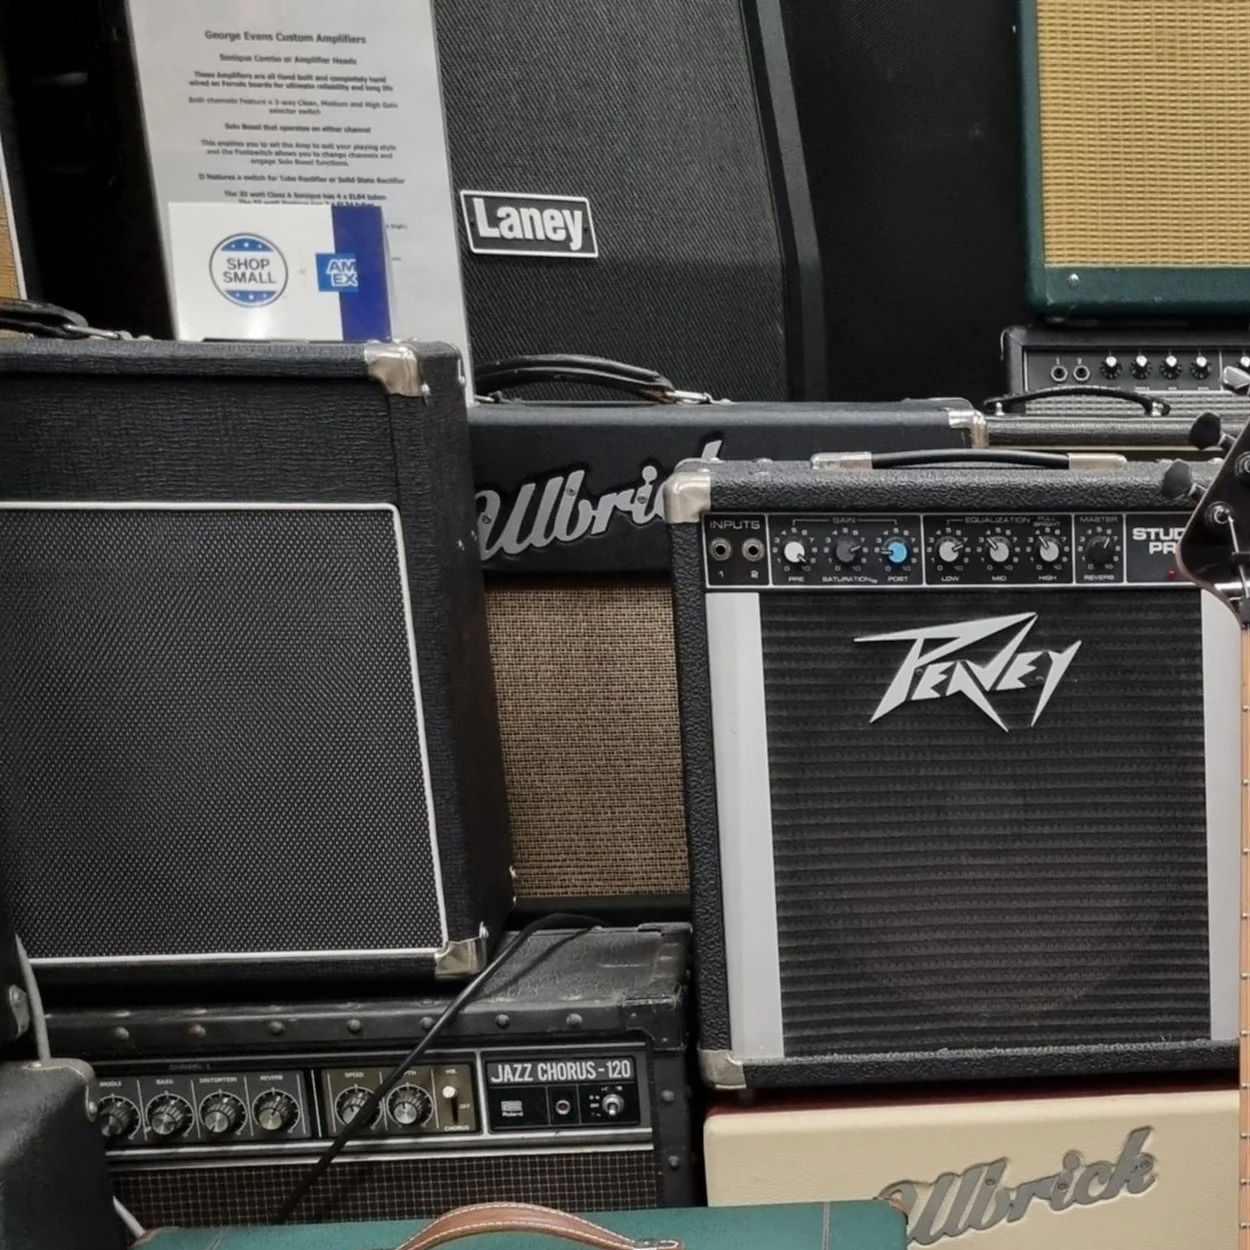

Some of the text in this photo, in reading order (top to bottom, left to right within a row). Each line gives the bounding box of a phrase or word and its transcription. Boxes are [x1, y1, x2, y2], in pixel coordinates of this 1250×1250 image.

[204, 30, 367, 45] George Evans Custom Amplifiers
[473, 198, 583, 251] Laney
[225, 258, 270, 271] SHOP
[326, 258, 356, 274] AM
[222, 271, 277, 284] SMALL
[331, 273, 358, 287] EX
[709, 520, 761, 530] INPUTS
[1131, 527, 1187, 541] STUD
[1149, 542, 1180, 554] PR
[491, 1063, 533, 1083] JAZZ
